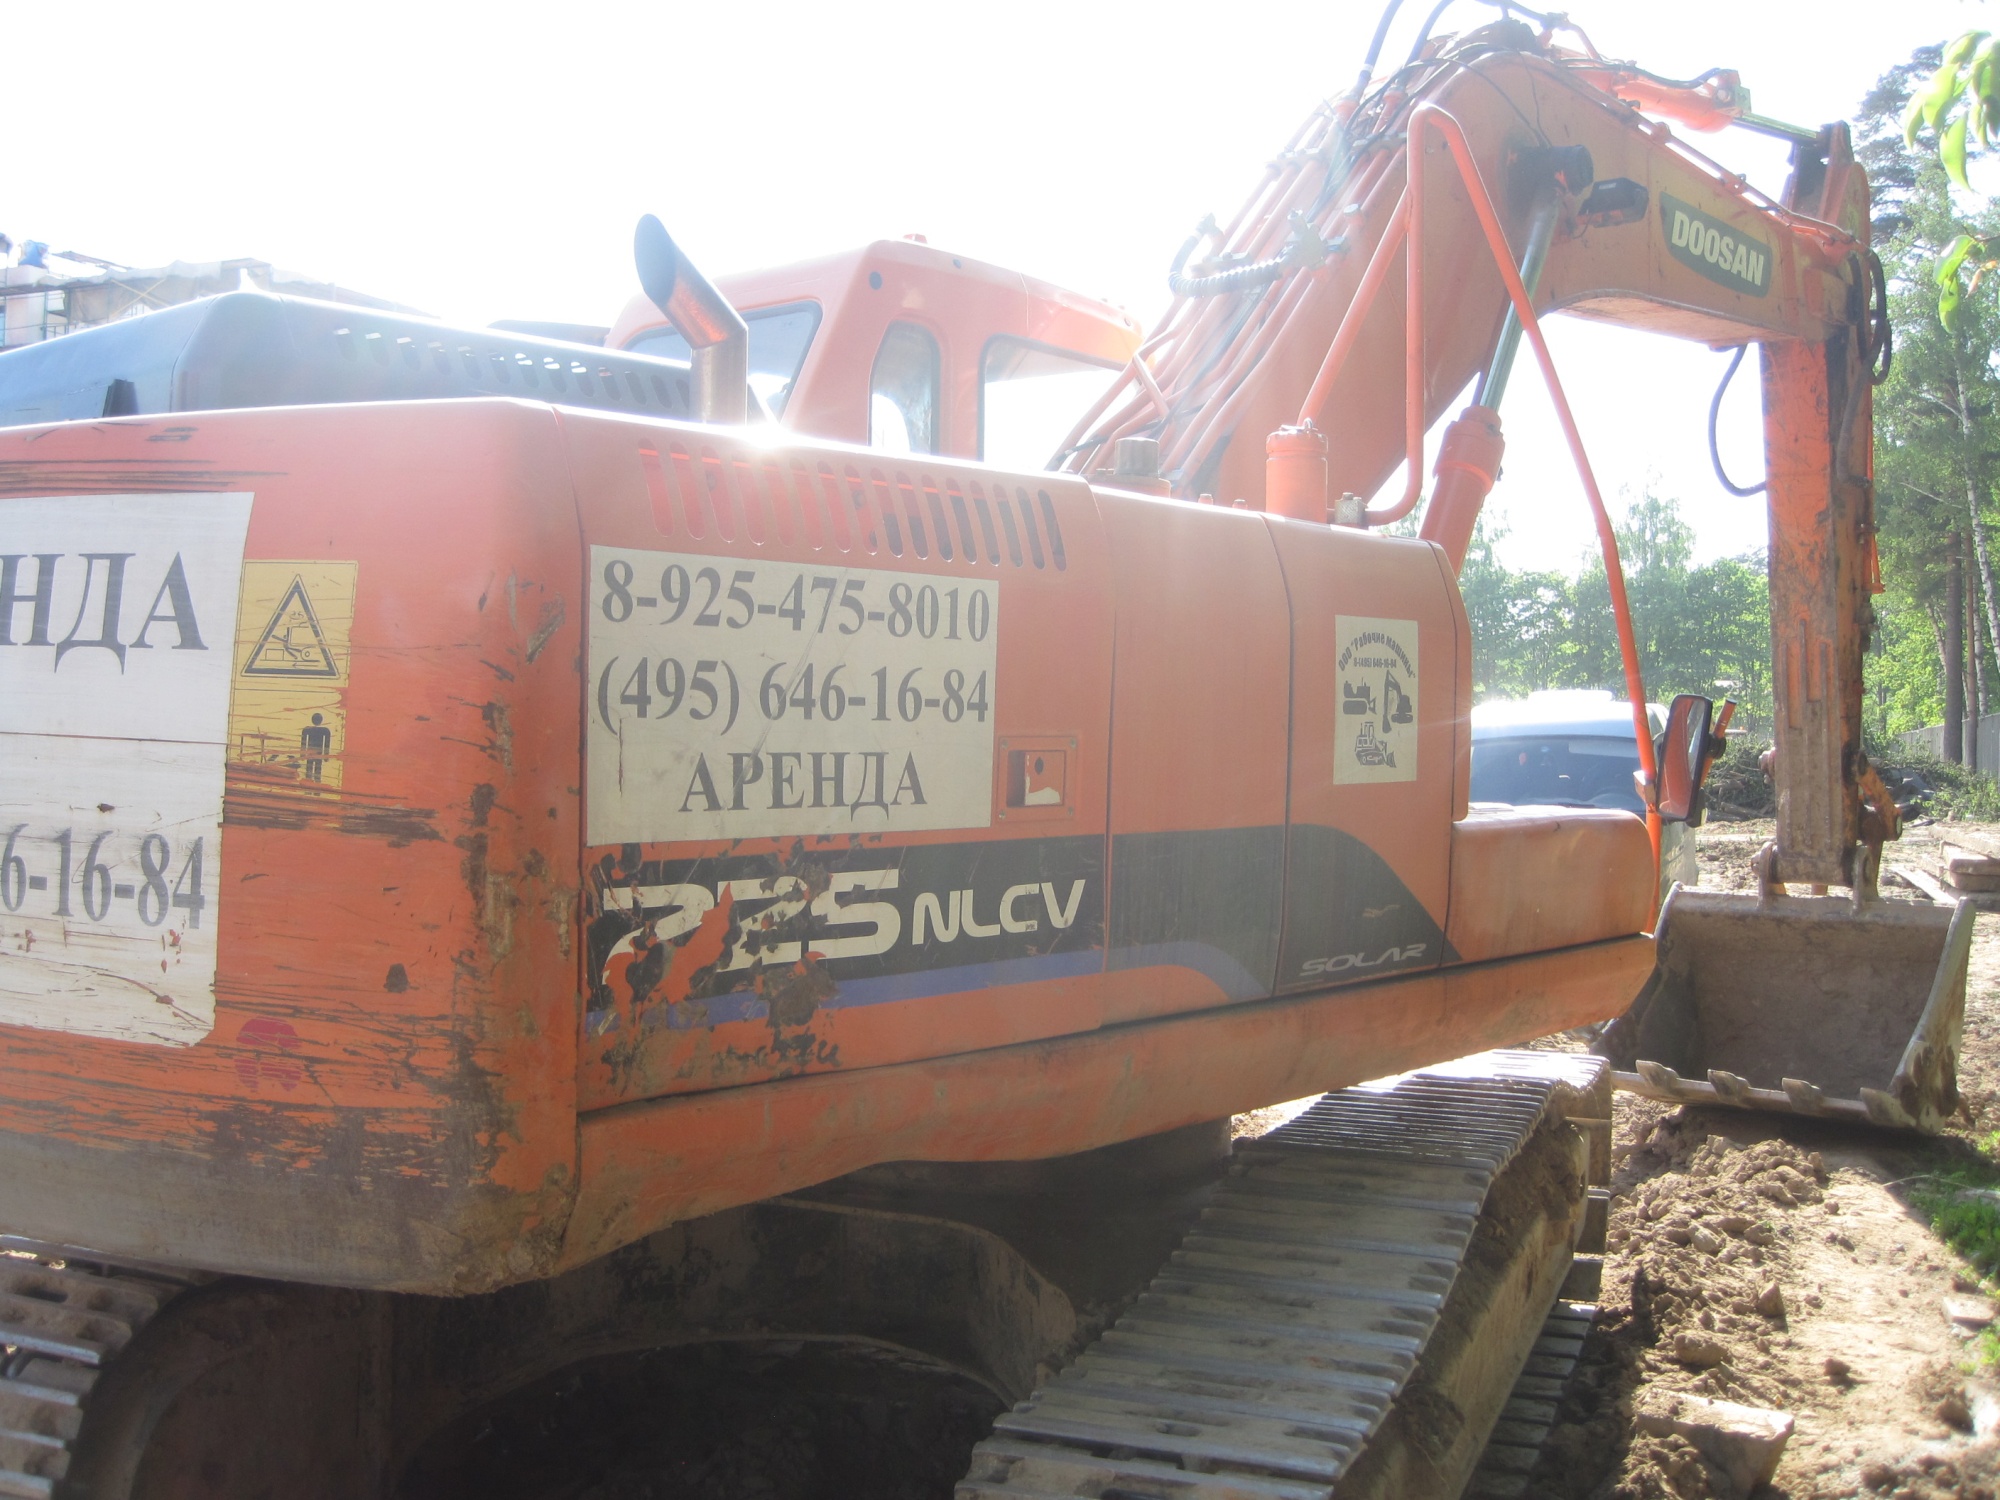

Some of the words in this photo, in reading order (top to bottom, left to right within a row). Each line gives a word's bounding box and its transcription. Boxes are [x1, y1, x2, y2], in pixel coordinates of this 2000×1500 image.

[1671, 210, 1764, 286] DOOSAN
[0, 551, 209, 675] НДА
[602, 560, 989, 641] 8-925-475-8010
[598, 656, 740, 735] (495)
[760, 661, 989, 722] 646-16-84
[1338, 646, 1352, 671] ООО
[679, 751, 927, 821] АРЕНДА
[0, 823, 205, 929] 6-16-84
[912, 879, 1086, 945] NLCV
[1299, 943, 1427, 976] SOLAR
